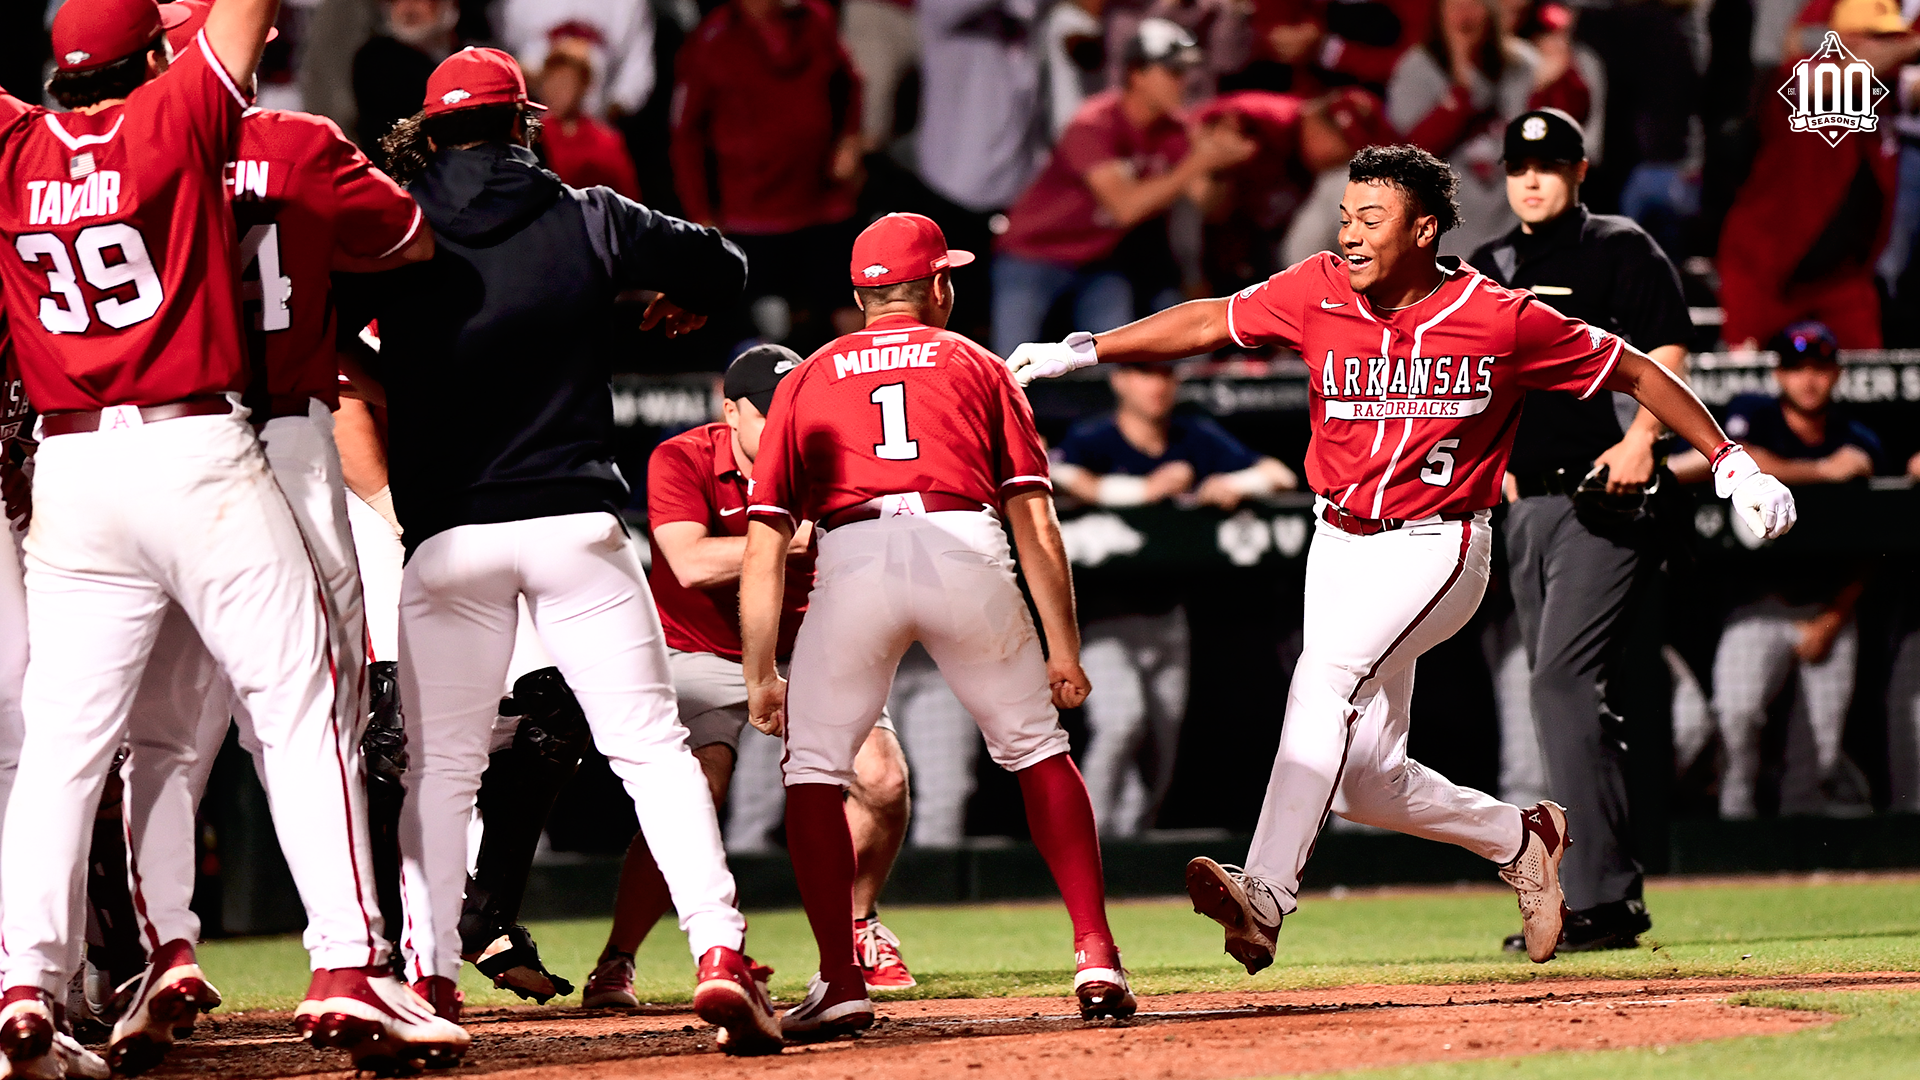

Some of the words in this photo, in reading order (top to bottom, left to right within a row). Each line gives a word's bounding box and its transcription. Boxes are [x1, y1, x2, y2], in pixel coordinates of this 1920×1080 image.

[15, 222, 164, 334] 39
[832, 341, 941, 380] MOORE
[1321, 349, 1497, 398] ARKANSAS
[869, 380, 920, 461] 1
[1353, 401, 1460, 418] RAZORBACKS
[1418, 437, 1461, 488] 5
